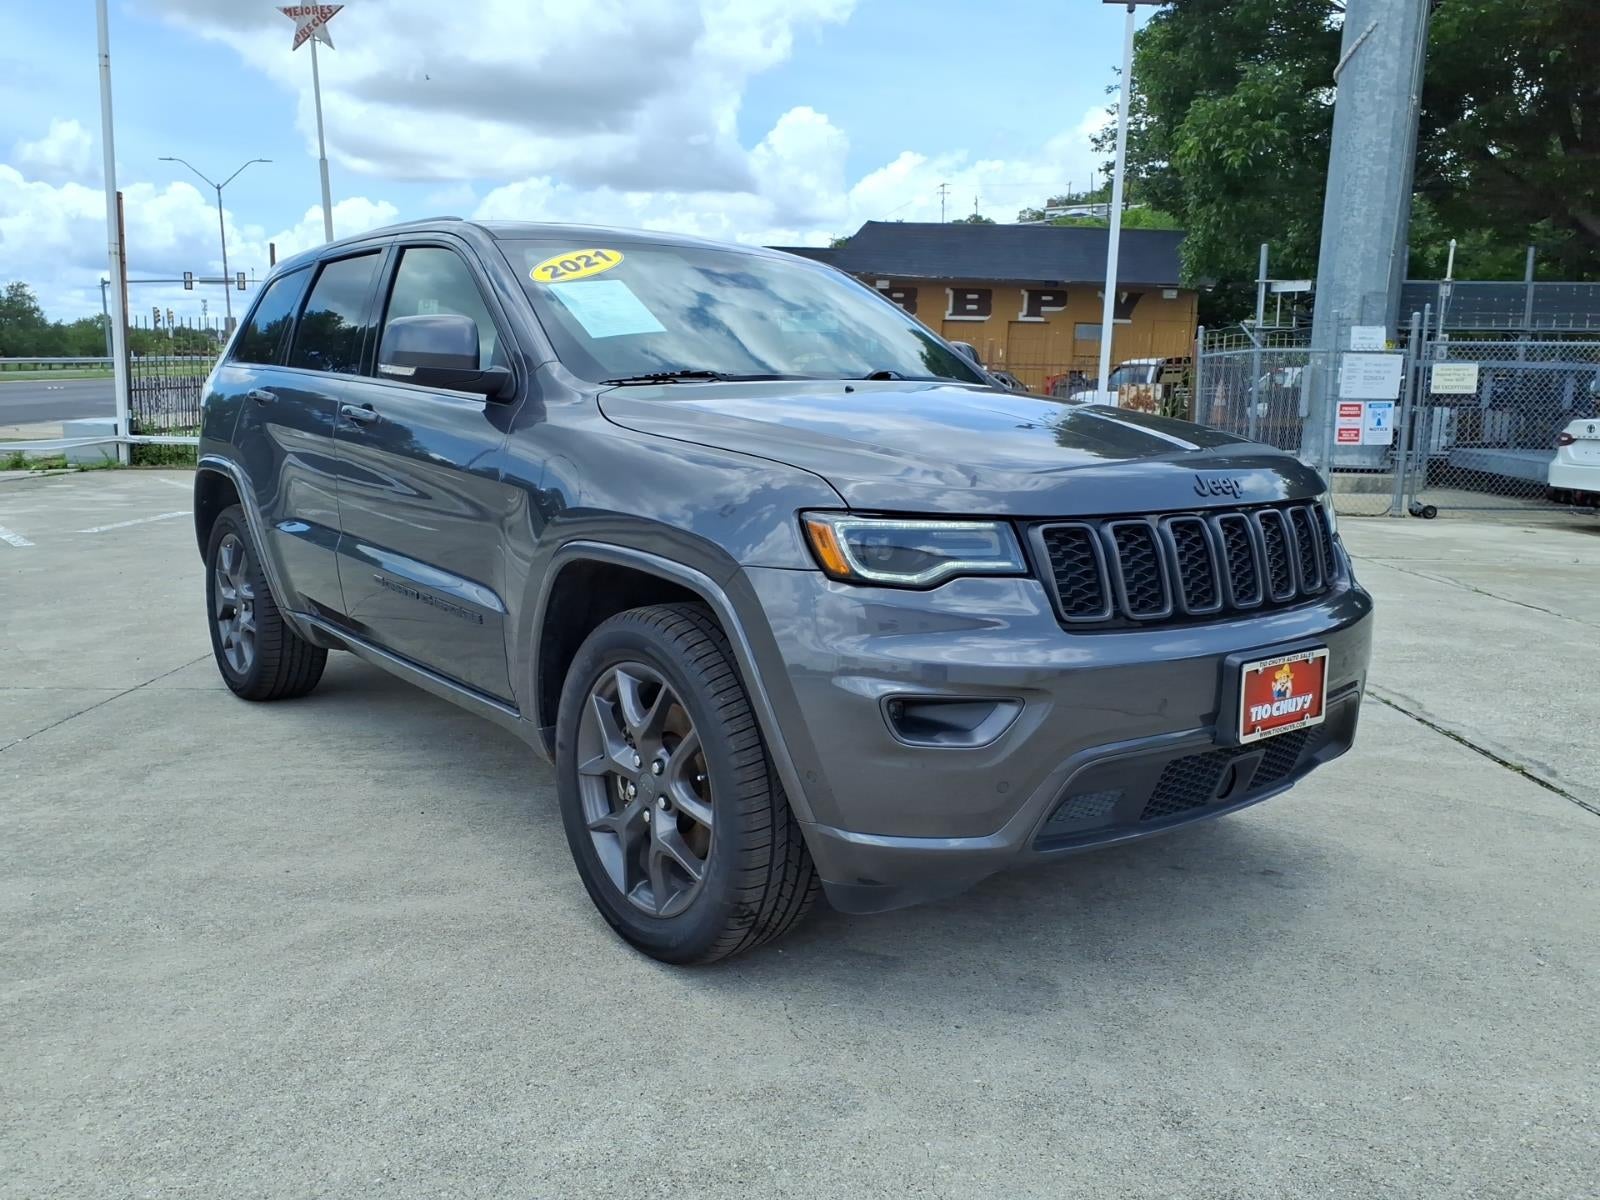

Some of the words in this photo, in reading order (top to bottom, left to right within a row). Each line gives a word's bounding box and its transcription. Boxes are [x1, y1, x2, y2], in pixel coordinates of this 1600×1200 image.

[283, 5, 333, 17] MEJORES
[541, 250, 613, 279] 2021
[1193, 474, 1243, 499] Jeep
[1250, 703, 1271, 721] TIO
